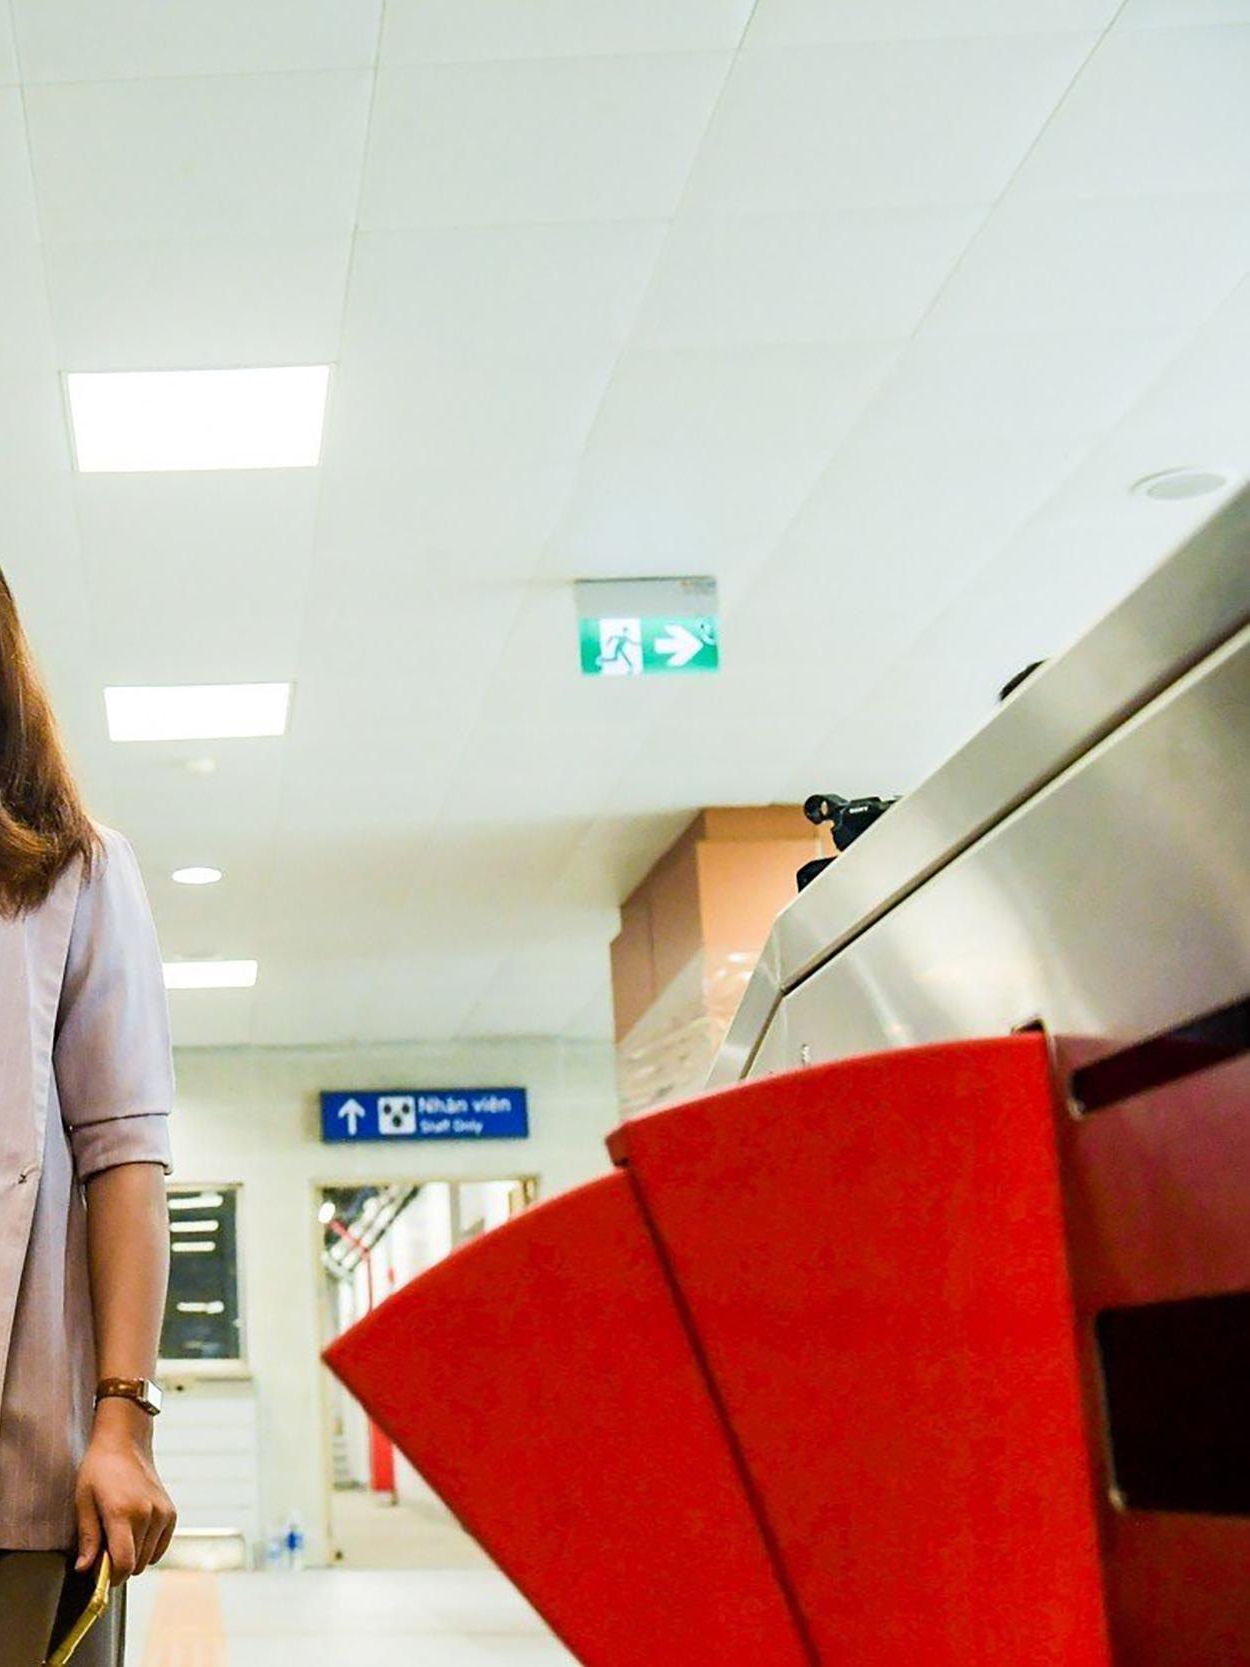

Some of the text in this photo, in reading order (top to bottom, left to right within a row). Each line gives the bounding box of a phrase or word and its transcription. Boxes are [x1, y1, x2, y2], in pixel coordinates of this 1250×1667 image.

[418, 1095, 512, 1114] Nhân viên
[419, 1118, 483, 1135] Staff Only
